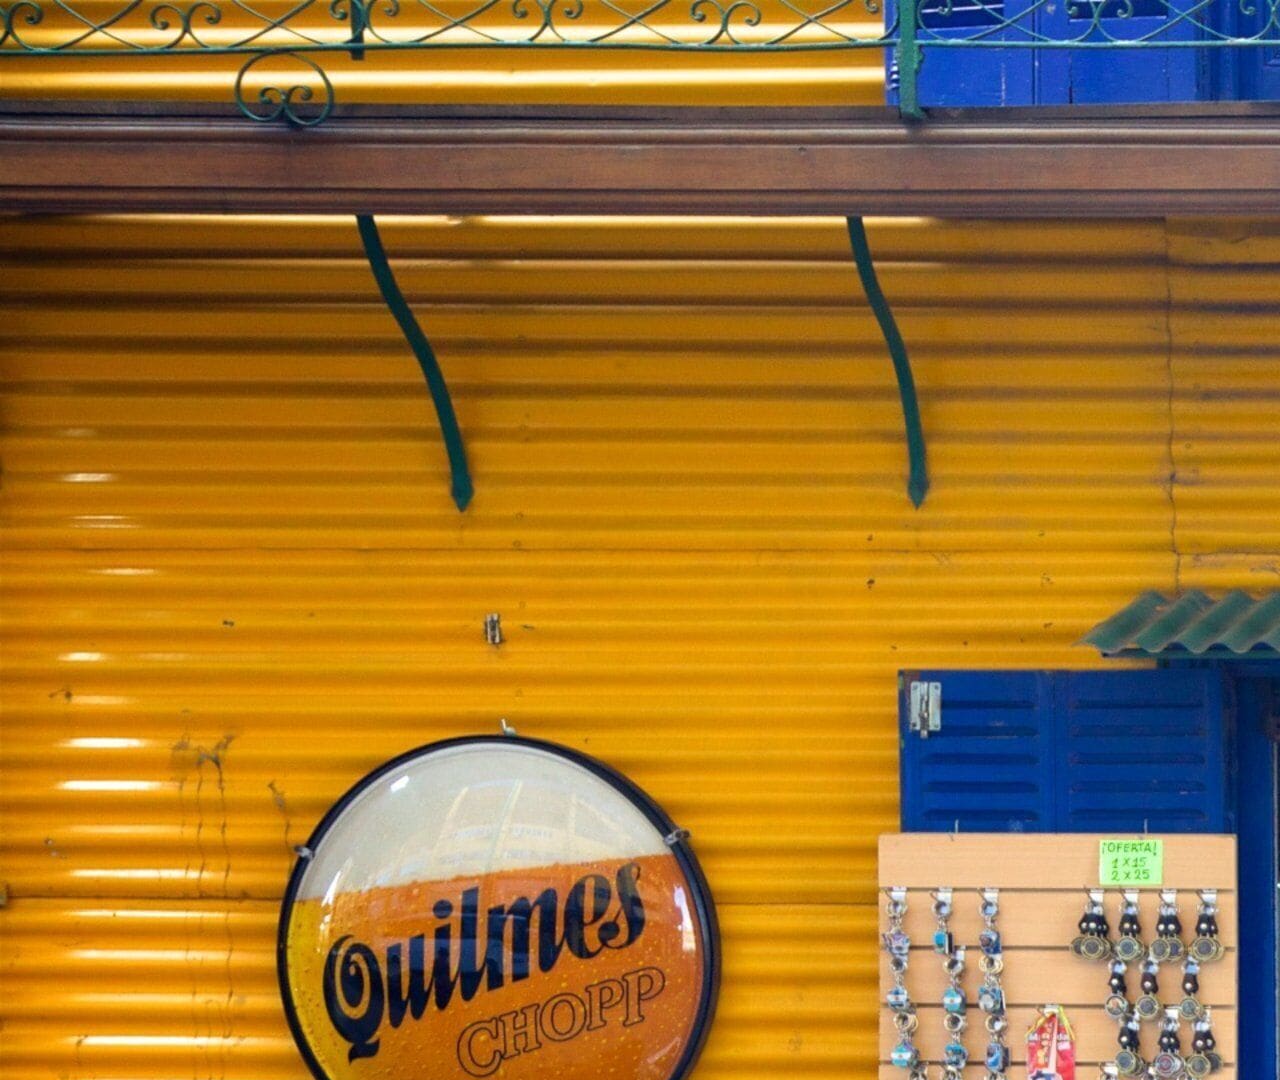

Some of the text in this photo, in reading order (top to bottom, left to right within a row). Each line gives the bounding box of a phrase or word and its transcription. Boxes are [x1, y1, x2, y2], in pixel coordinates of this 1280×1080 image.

[1103, 841, 1157, 856] ¡OFERTA!
[1112, 857, 1118, 869] 1
[1132, 856, 1147, 868] 15
[1111, 870, 1120, 881] 2
[1134, 869, 1150, 880] 25
[322, 862, 646, 1064] Quilmes
[456, 966, 666, 1078] CHOPP
